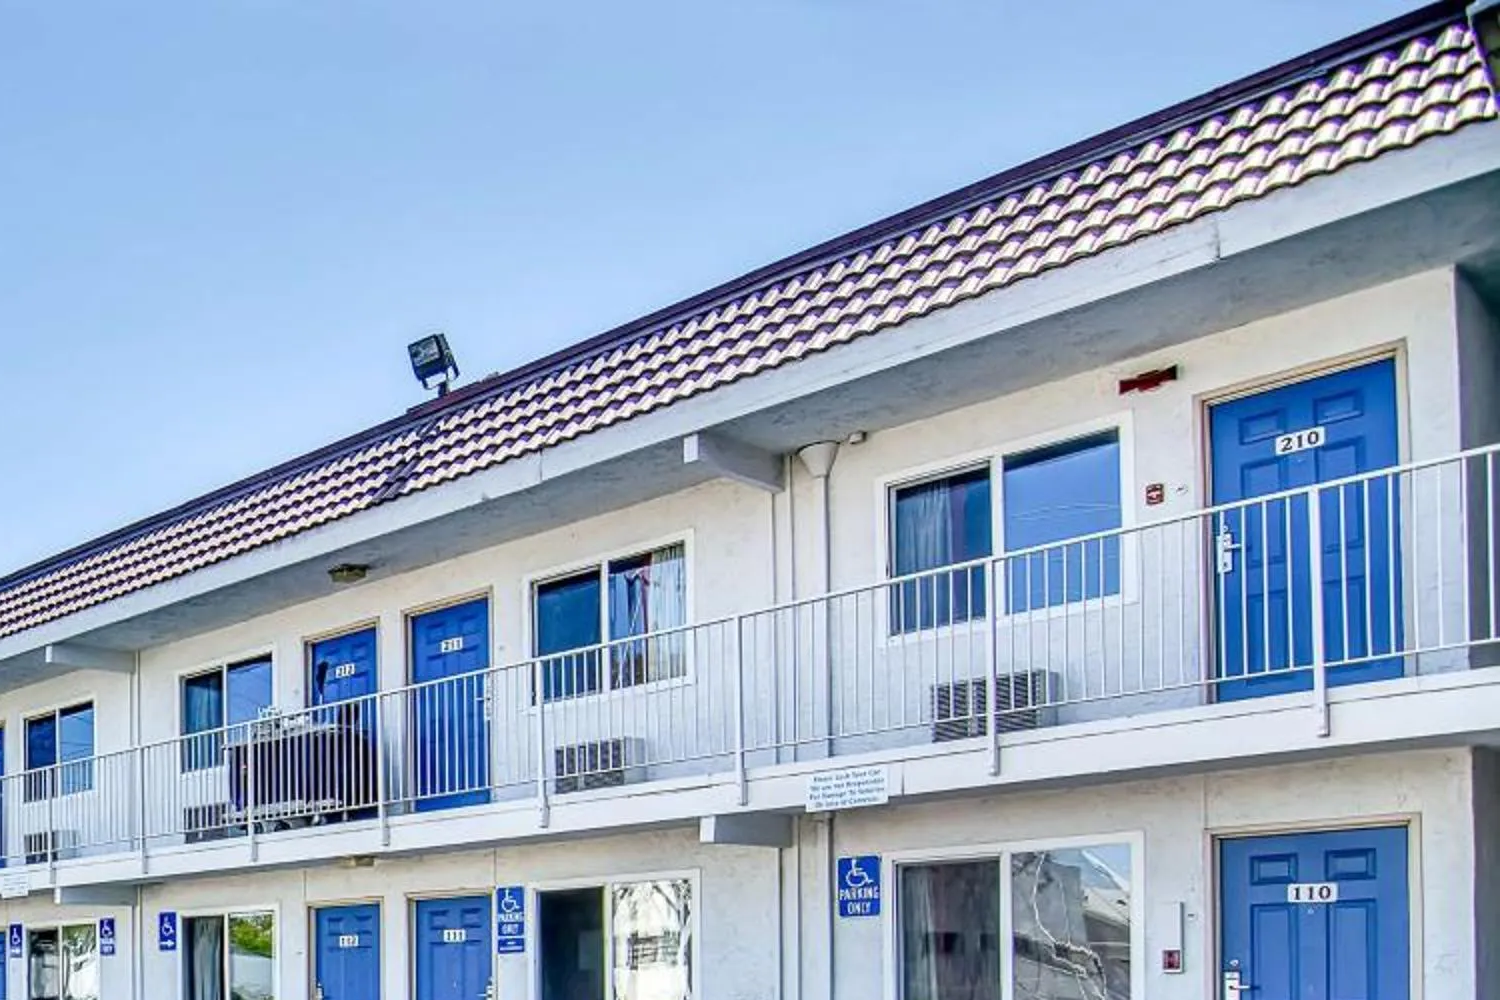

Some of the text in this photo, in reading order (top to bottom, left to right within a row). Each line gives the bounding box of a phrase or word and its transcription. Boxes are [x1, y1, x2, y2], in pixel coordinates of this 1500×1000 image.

[1280, 431, 1319, 452] 210
[840, 886, 879, 901] PARKING
[1294, 886, 1331, 901] 110
[847, 901, 871, 914] ONLY
